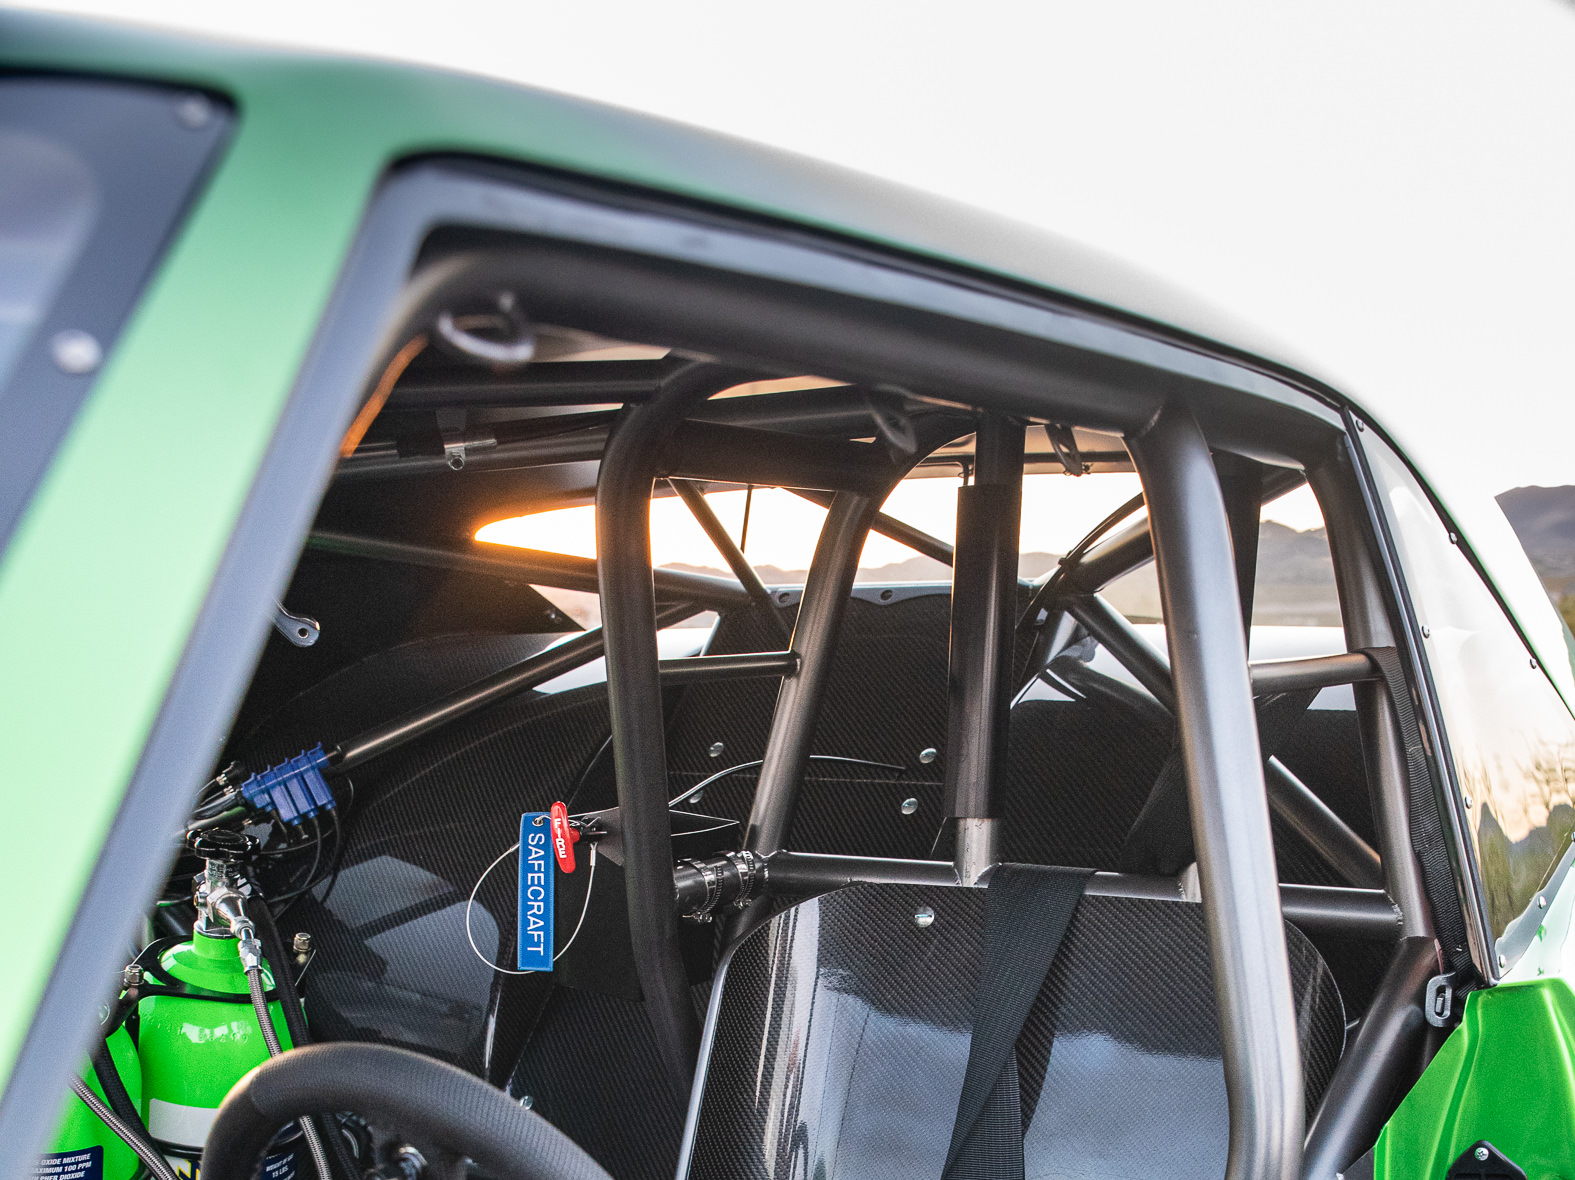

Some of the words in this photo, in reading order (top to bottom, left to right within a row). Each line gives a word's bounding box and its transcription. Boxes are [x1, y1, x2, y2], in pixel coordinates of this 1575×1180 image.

[553, 818, 567, 858] FIRE
[527, 833, 545, 956] SAFECRAFT
[41, 1158, 61, 1166] OXIDE
[62, 1153, 91, 1164] MIXTURE
[64, 1164, 77, 1173] 100
[77, 1161, 92, 1170] PPM
[59, 1170, 86, 1180] DIOXIDE
